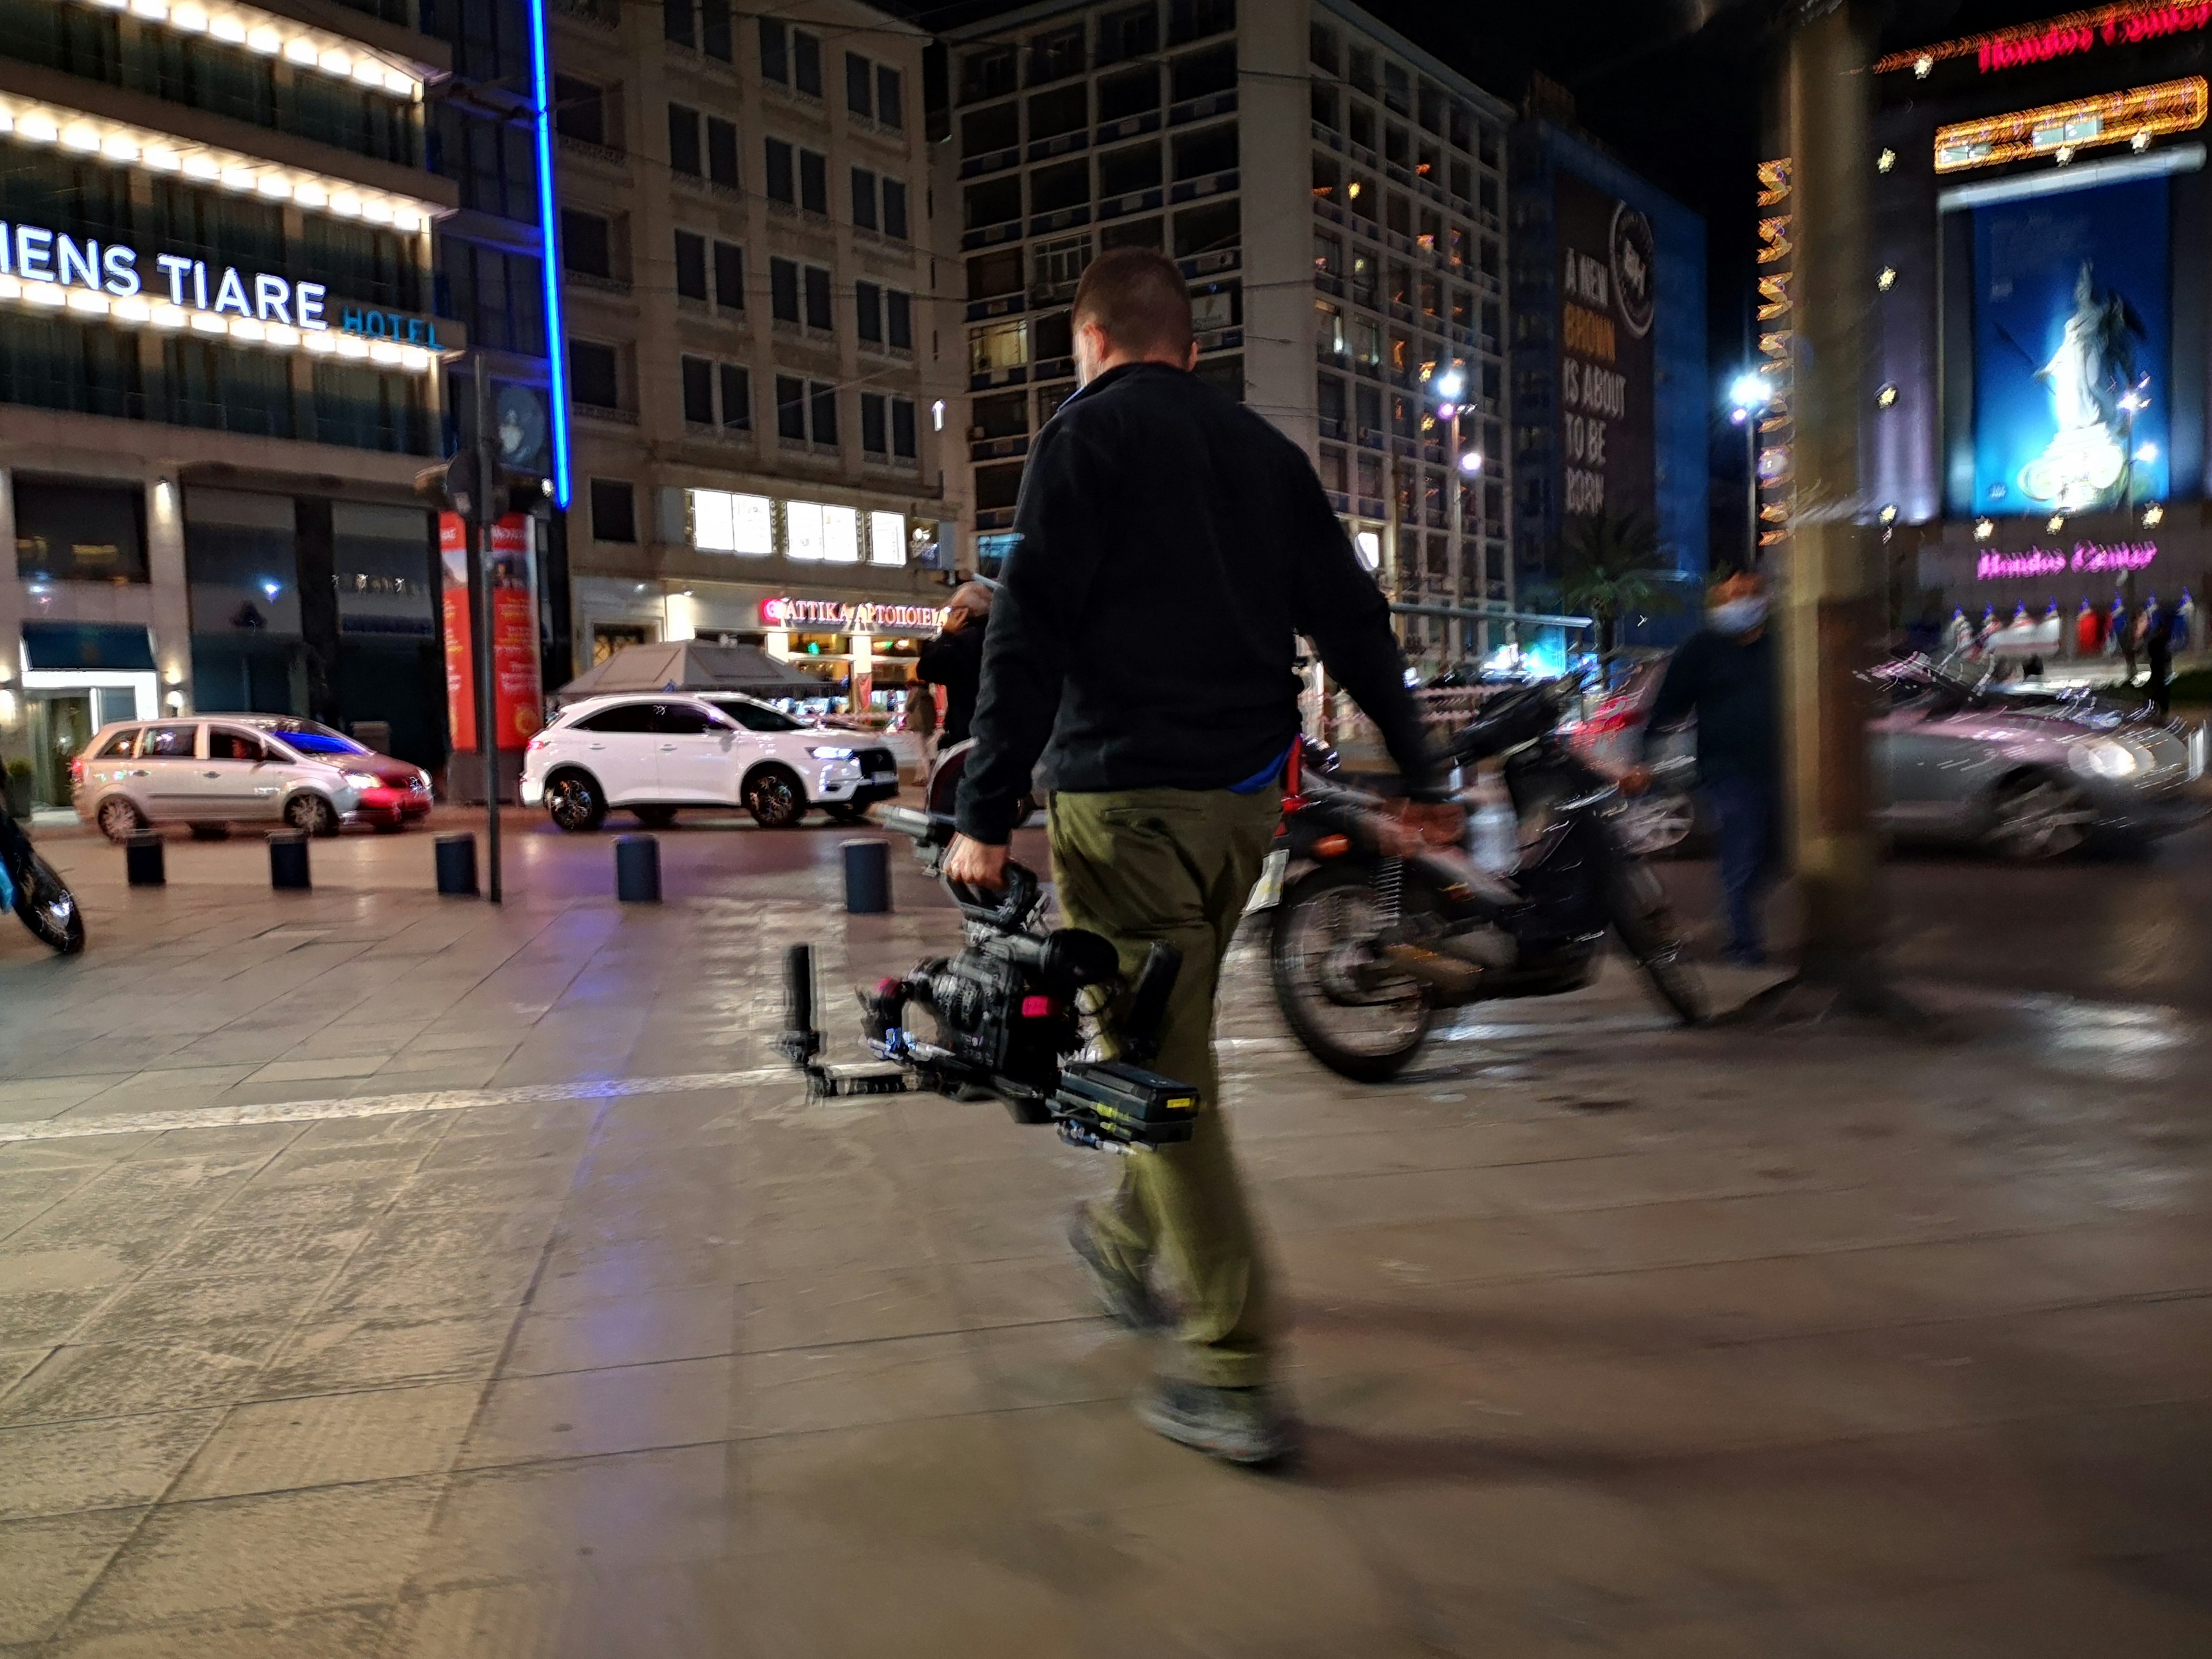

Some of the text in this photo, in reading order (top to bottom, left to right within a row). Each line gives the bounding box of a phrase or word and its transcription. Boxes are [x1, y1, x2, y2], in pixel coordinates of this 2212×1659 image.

[0, 220, 446, 350] ENS TIARE HOTEL
[1565, 247, 1577, 295] A
[1562, 356, 1626, 420] IS ABOUT
[1565, 410, 1607, 465] TO BE
